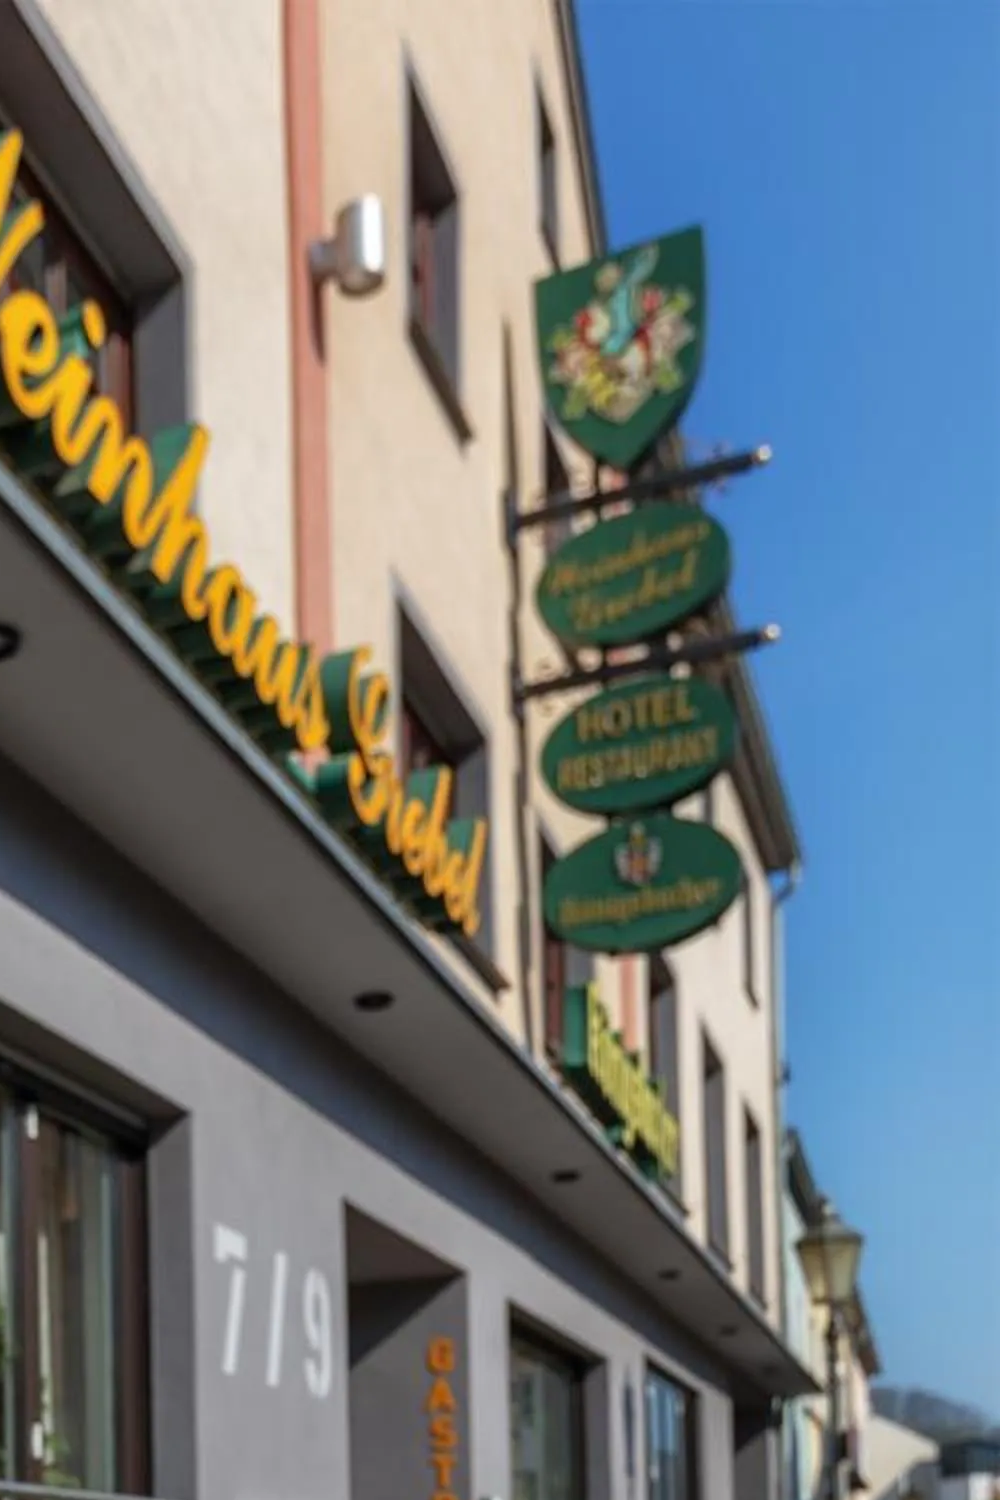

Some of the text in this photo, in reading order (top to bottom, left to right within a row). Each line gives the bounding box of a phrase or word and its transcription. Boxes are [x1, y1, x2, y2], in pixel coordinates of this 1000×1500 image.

[577, 685, 697, 743] HOTEL
[347, 643, 488, 939] Grebel
[557, 726, 719, 793] RESTAURANT
